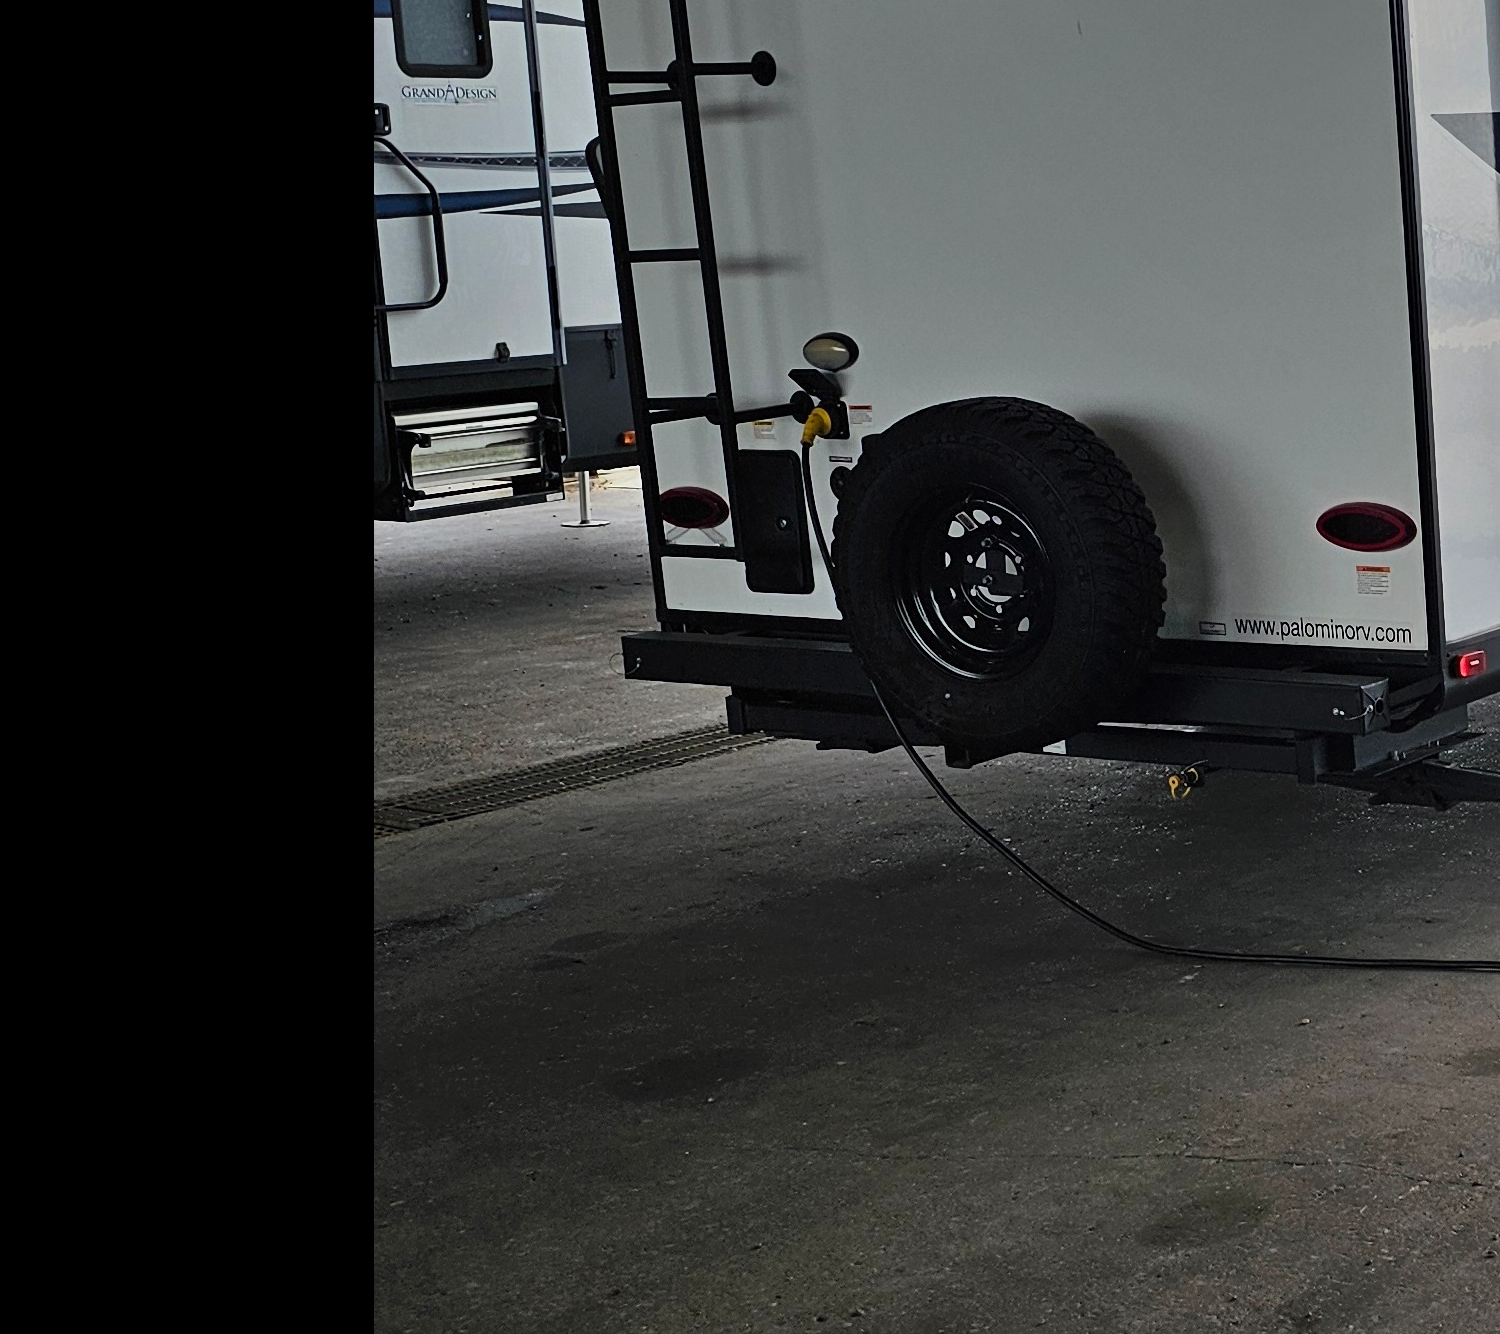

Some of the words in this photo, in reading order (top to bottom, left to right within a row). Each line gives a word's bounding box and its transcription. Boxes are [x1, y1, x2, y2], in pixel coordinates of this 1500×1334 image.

[401, 86, 445, 98] GRAND
[455, 87, 497, 99] DESIGN
[1235, 617, 1412, 643] www.palominorv.com
